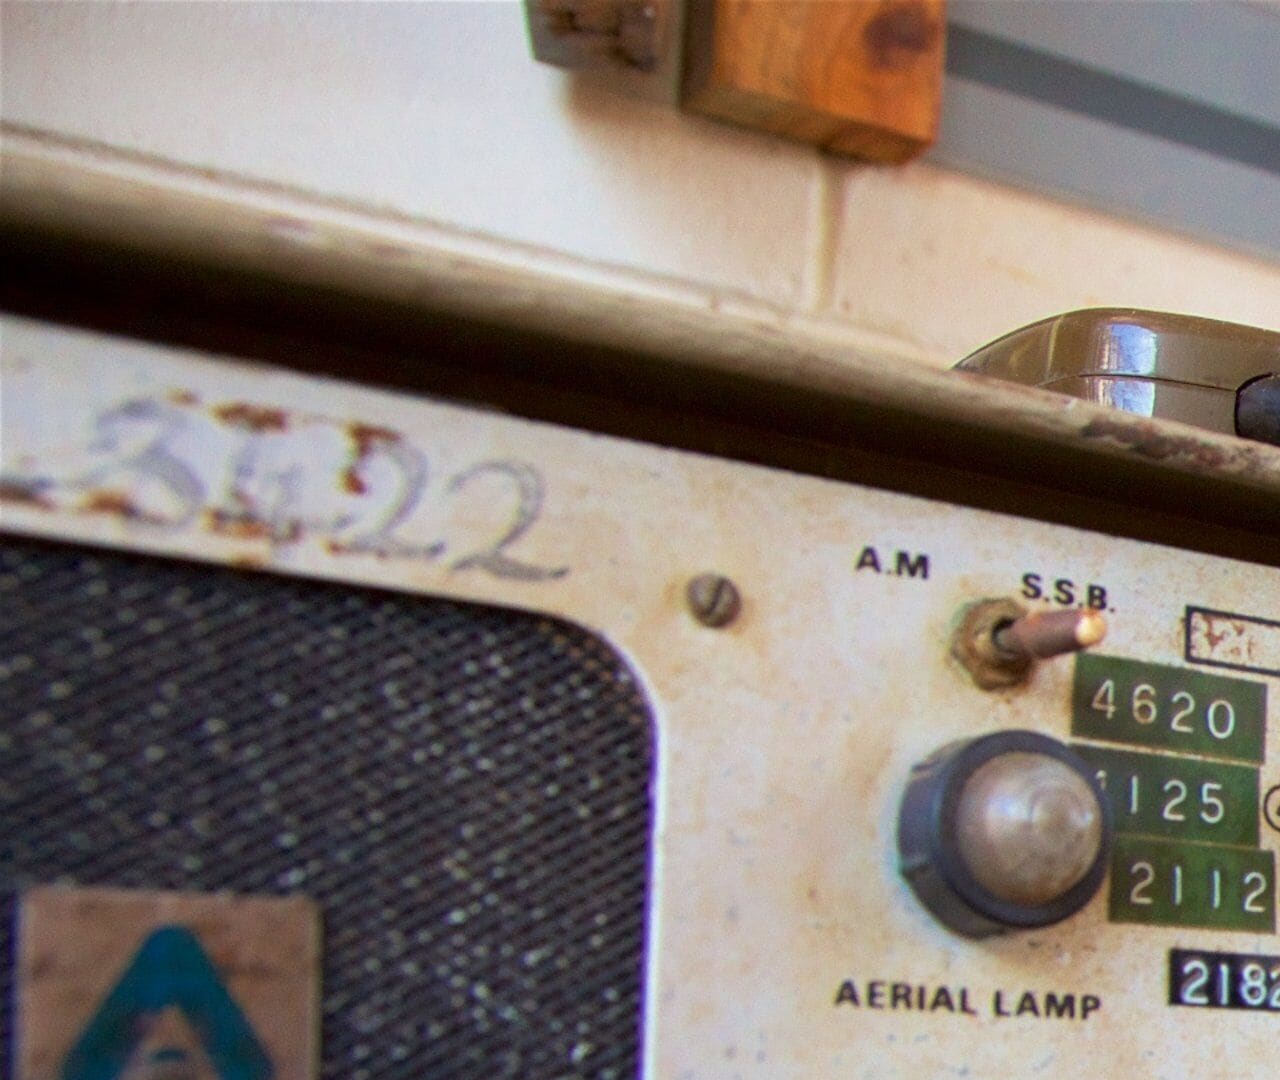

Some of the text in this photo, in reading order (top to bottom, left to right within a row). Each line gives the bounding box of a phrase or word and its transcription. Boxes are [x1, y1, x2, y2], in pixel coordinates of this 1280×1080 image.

[855, 546, 930, 580] A.M
[1091, 679, 1236, 739] 4620
[1130, 861, 1267, 913] 2112
[834, 980, 1102, 1020] AERIAL LAMP
